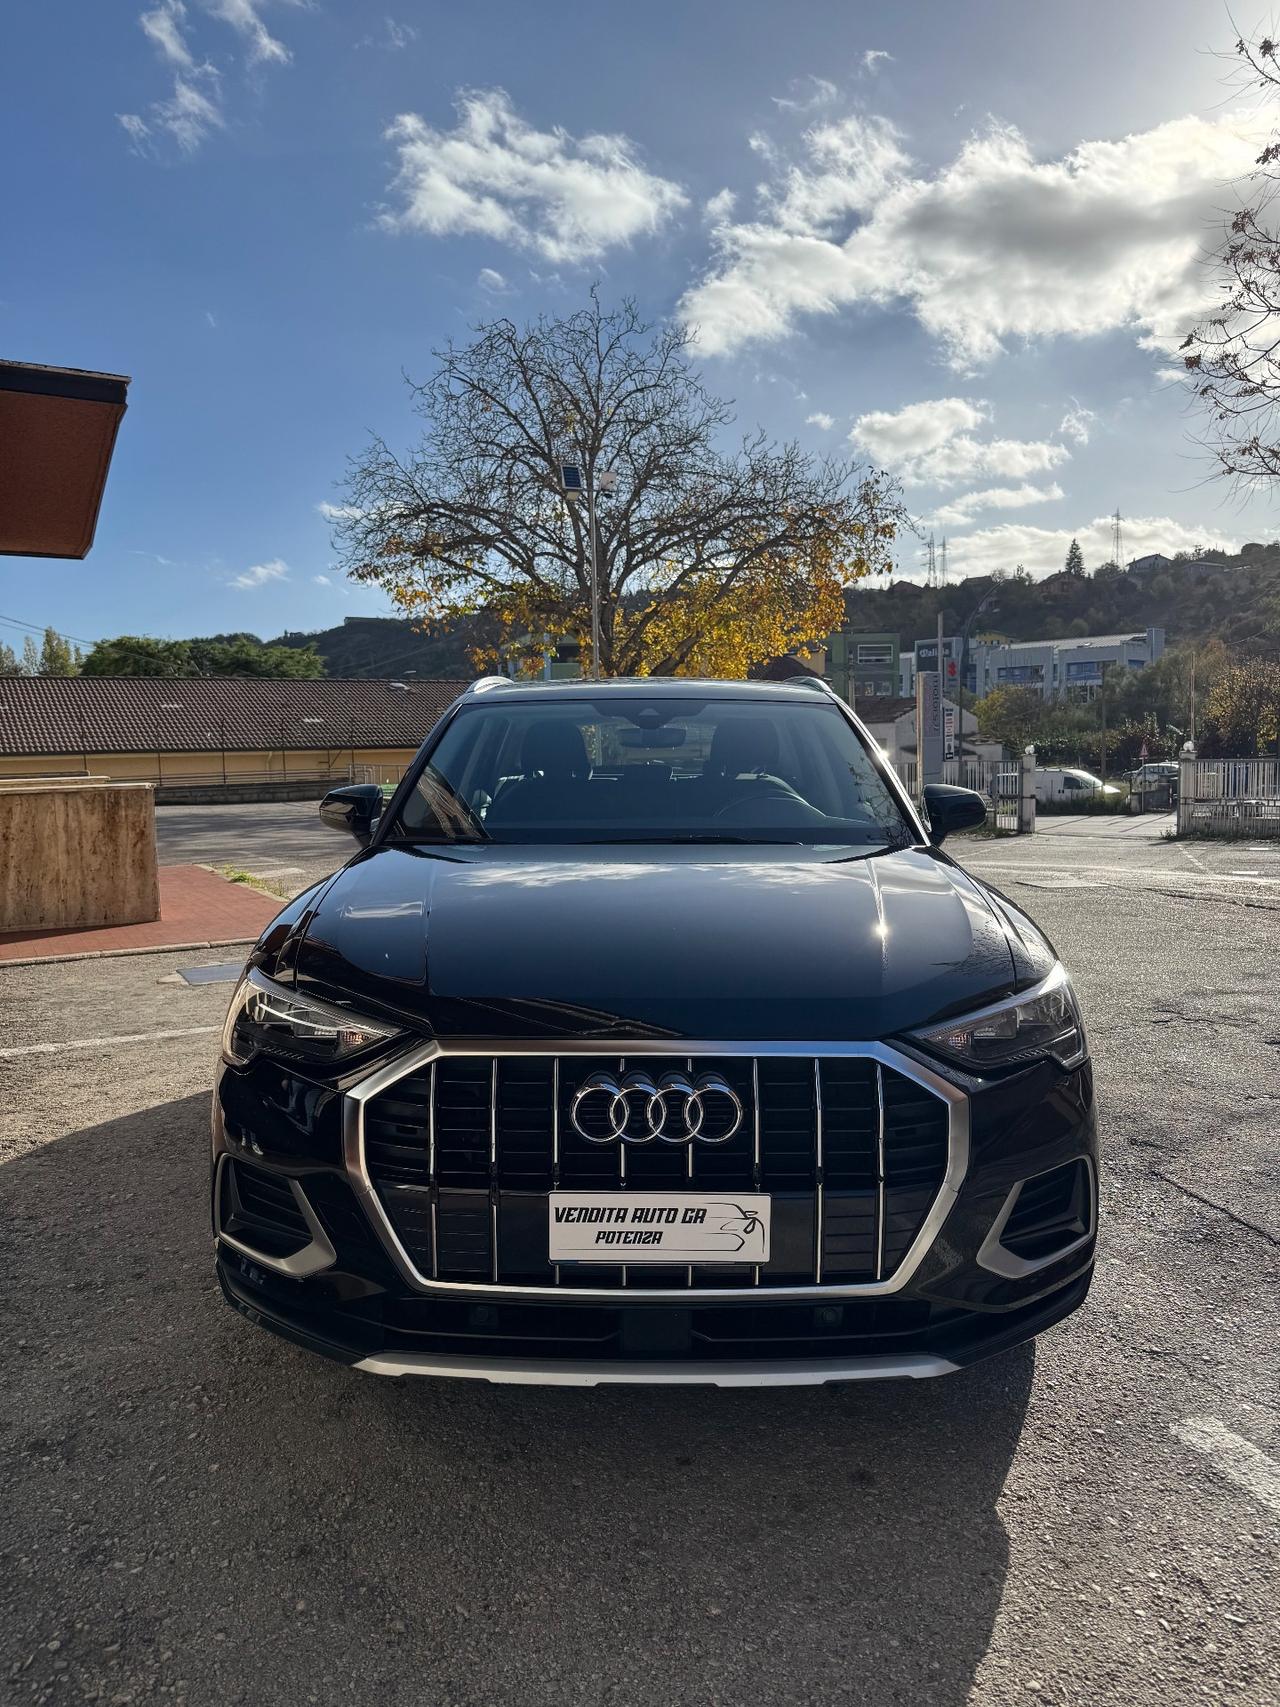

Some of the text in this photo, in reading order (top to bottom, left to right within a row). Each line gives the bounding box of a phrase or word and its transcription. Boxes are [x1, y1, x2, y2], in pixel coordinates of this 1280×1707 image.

[554, 1207, 629, 1223] VENDITA
[631, 1207, 679, 1224] AUTO
[595, 1231, 663, 1244] POTENZA
